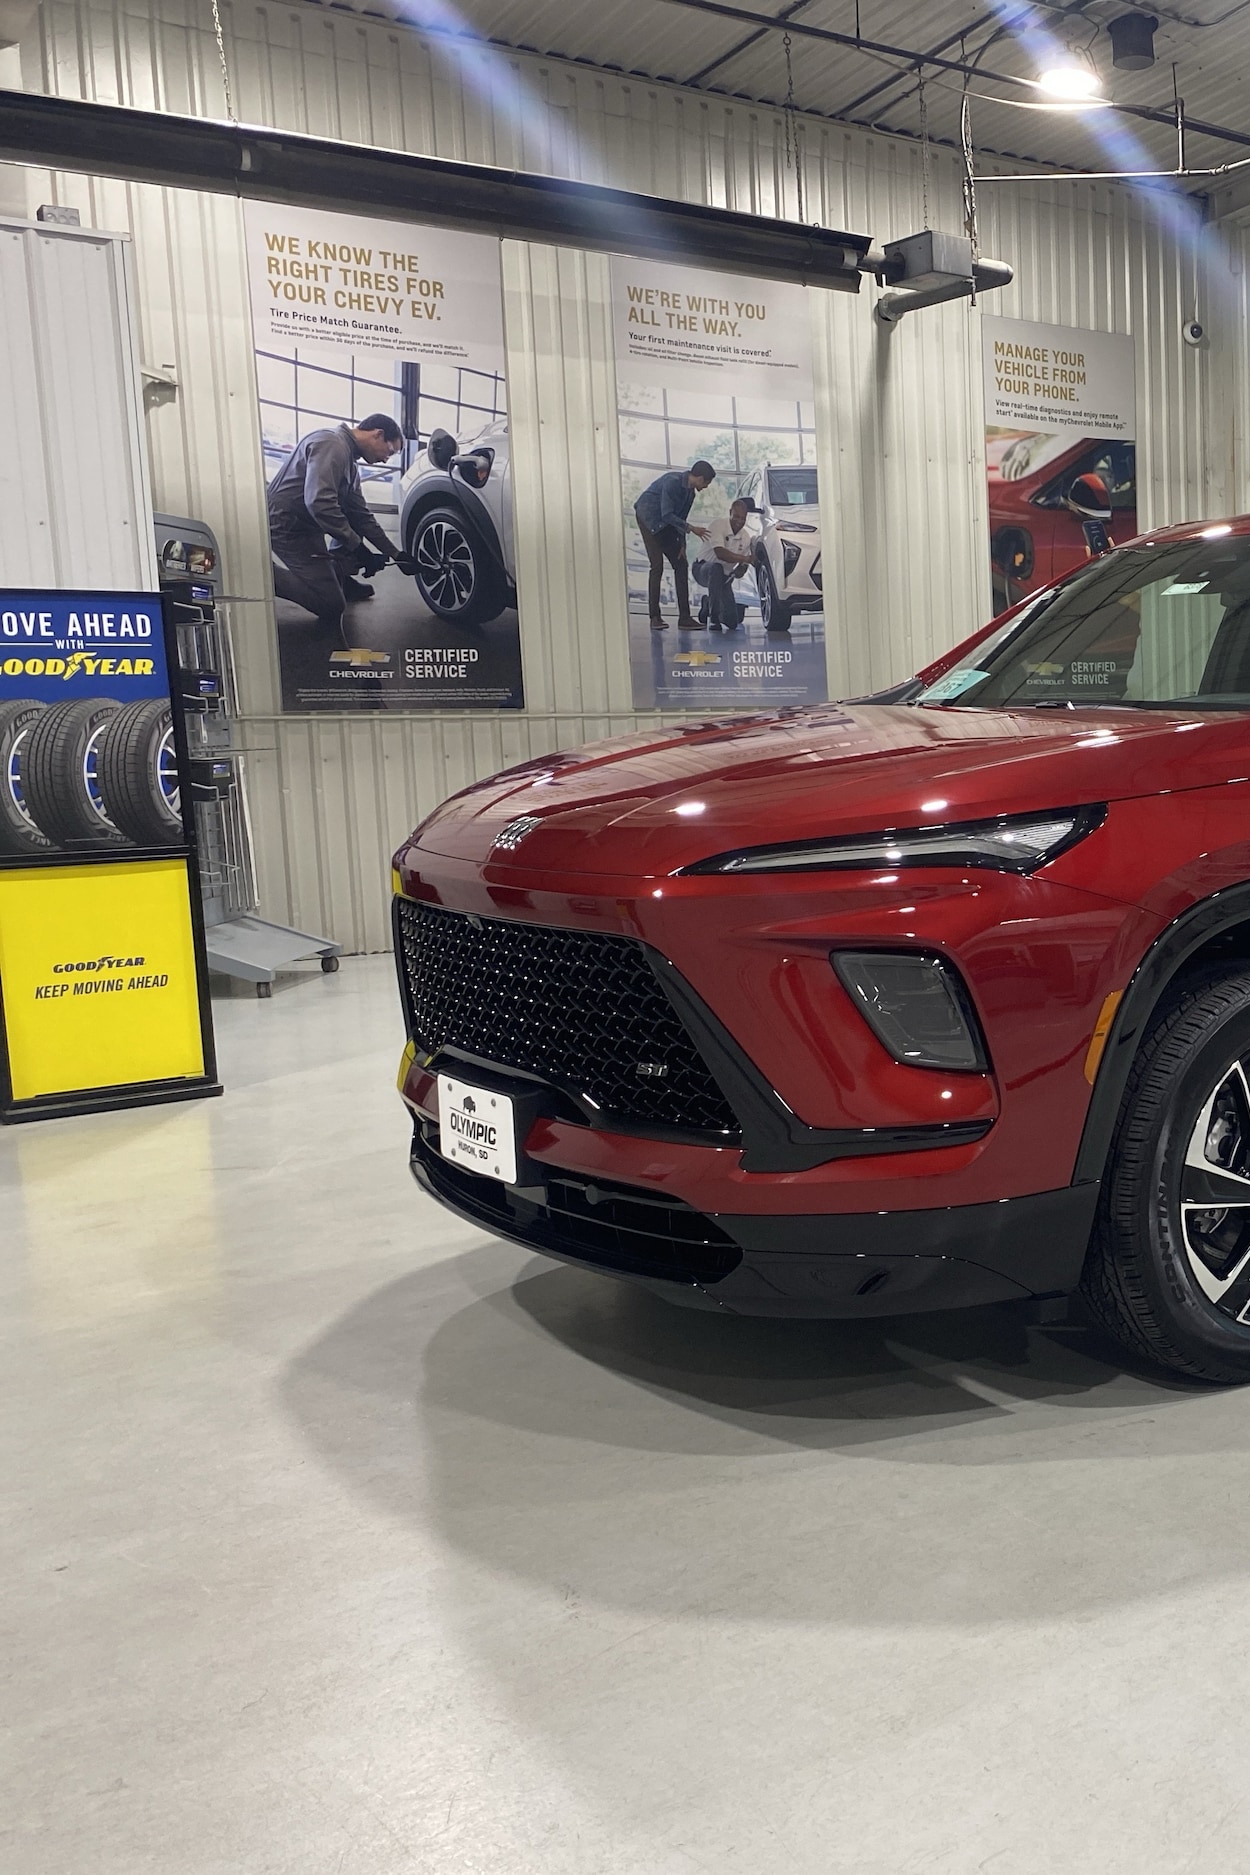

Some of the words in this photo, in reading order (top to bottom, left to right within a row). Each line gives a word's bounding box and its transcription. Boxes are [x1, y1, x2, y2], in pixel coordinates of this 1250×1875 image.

[264, 232, 301, 256] WE
[307, 239, 372, 266] KNOW
[379, 250, 419, 273] THE
[267, 256, 332, 283] RIGHT
[339, 267, 399, 293] TIRES
[406, 277, 445, 299] FOR
[267, 279, 327, 305] YOUR
[334, 290, 404, 317] CHEVY
[411, 302, 442, 321] EV.
[627, 285, 681, 309] WE'RE
[686, 295, 730, 316] WITH
[734, 302, 766, 321] YOU
[270, 307, 290, 319] Tire
[292, 311, 318, 323] Price
[320, 315, 349, 328] Match
[351, 320, 403, 334] Guarantee.
[628, 306, 661, 327] ALL
[665, 312, 698, 332] THE
[703, 318, 742, 338] WAY.
[628, 331, 646, 342] Your
[648, 334, 665, 345] first
[667, 339, 715, 352] maintenance
[716, 344, 732, 354] visit
[733, 346, 740, 354] is
[994, 340, 1048, 363] MANAGE
[1052, 350, 1085, 367] YOUR
[994, 359, 1049, 381] VEHICLE
[1052, 367, 1086, 385] FROM
[994, 377, 1030, 395] YOUR
[1034, 383, 1080, 402] PHONE.
[995, 399, 1010, 408] View
[1010, 402, 1038, 412] real-time
[1039, 405, 1071, 416] diagnostics
[1072, 409, 1083, 418] and
[1083, 411, 1098, 420] enjoy
[1013, 411, 1039, 421] available
[1048, 415, 1058, 423] the
[1058, 417, 1094, 427] myChevrolet
[1094, 420, 1112, 428] Mobile
[67, 613, 151, 637] AHEAD
[55, 639, 84, 650] WITH
[405, 649, 479, 663] CERTIFIED
[733, 651, 792, 663] CERTIFIED
[0, 657, 154, 677] OODYEAR
[329, 670, 395, 679] CHEVROLET
[405, 664, 467, 678] SERVICE
[671, 670, 725, 678] CHEVROLET
[733, 665, 783, 678] SERVICE
[1071, 661, 1116, 673] CERTIFIED
[1071, 673, 1109, 685] SERVICE
[53, 957, 146, 974] GOODYEAR
[34, 983, 70, 999] KEEP
[72, 978, 123, 995] MOVING
[127, 974, 169, 990] AHEAD
[450, 1112, 497, 1145] OLYMPIC
[478, 1149, 488, 1160] SD
